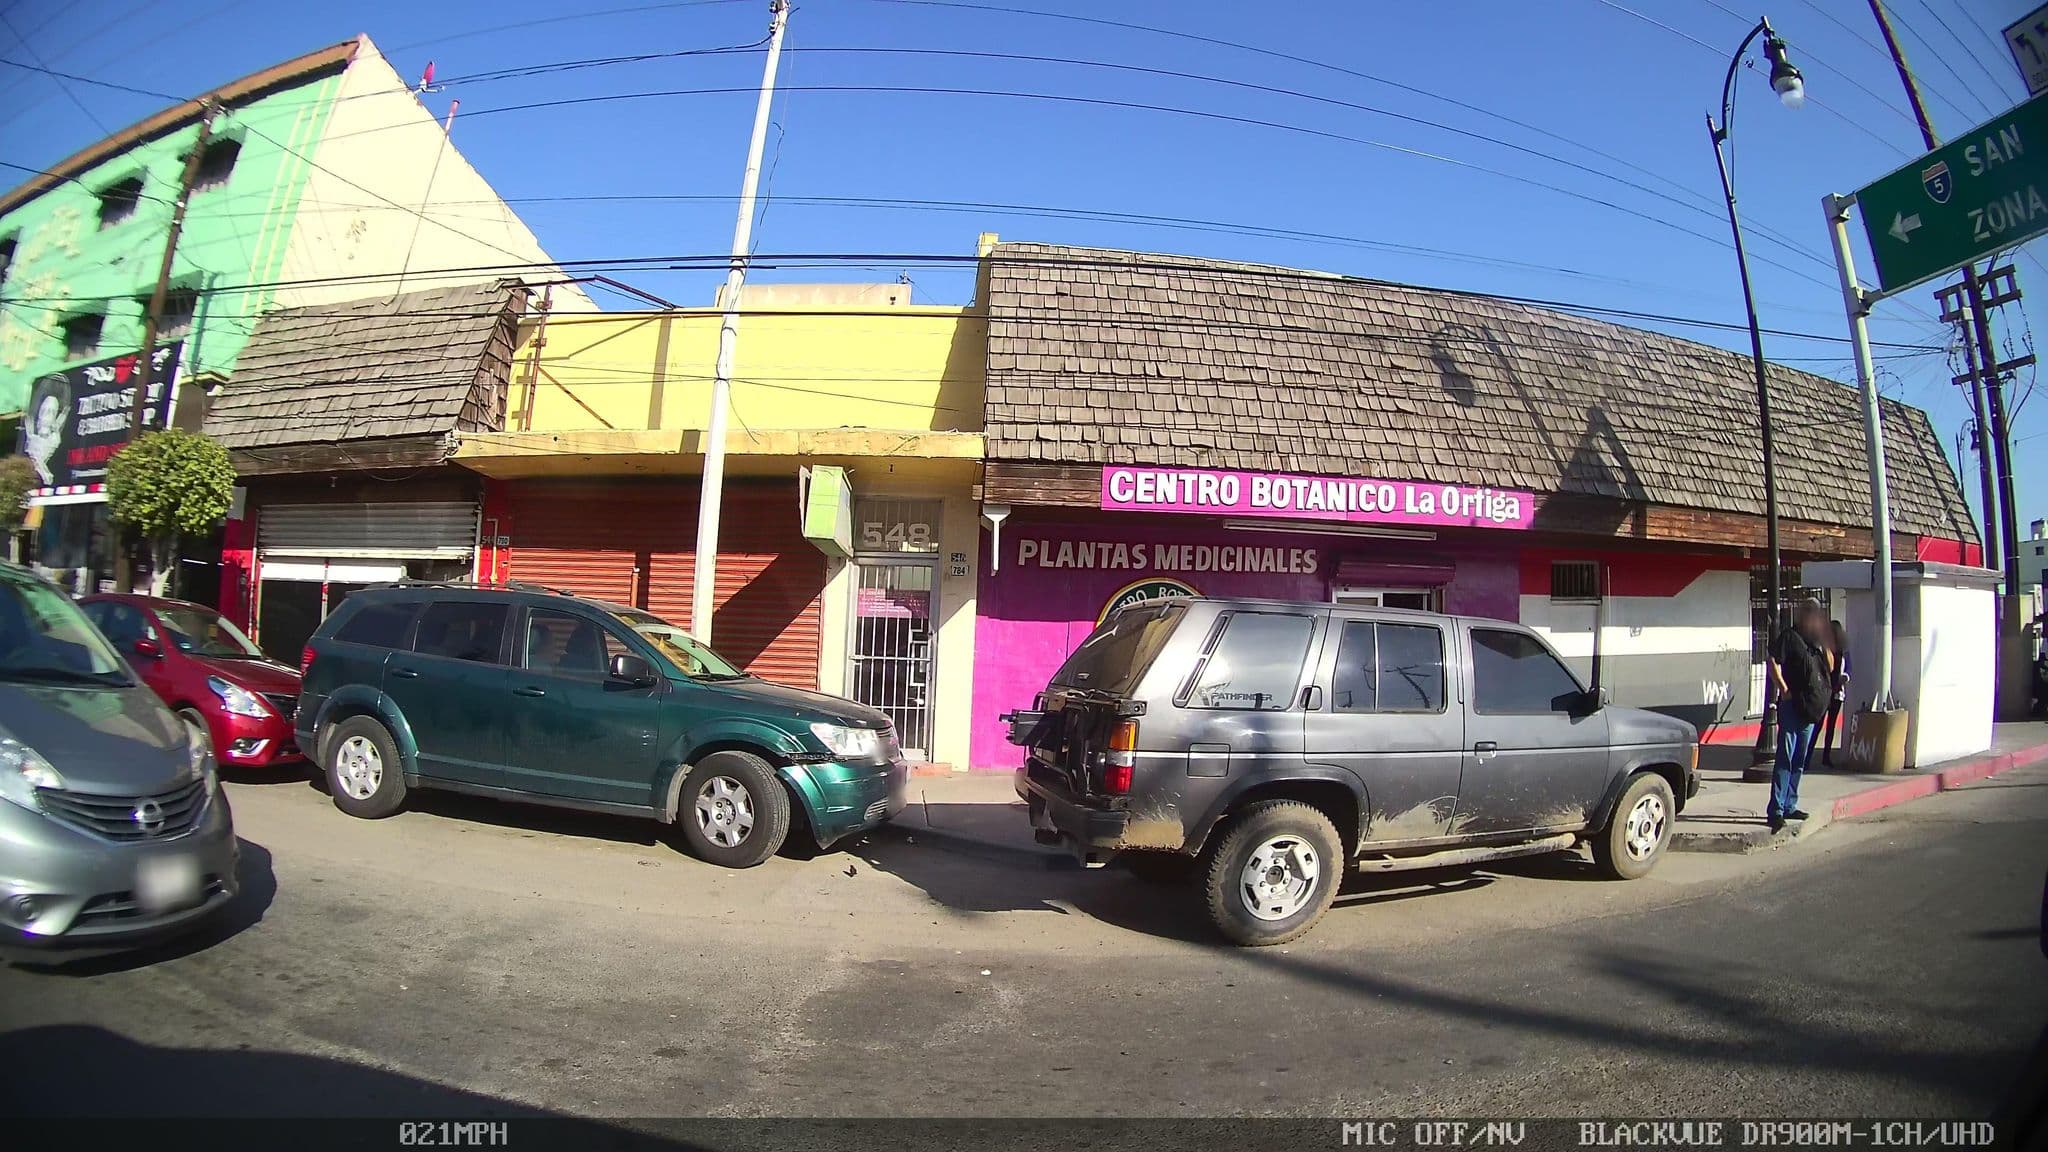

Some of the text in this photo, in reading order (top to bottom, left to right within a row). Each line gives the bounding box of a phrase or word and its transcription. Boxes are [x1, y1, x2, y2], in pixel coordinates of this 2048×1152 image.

[1964, 123, 2024, 176] SAN
[1934, 178, 1944, 194] 5
[1967, 185, 2048, 243] ZONA
[1109, 470, 1521, 523] CENTRO BOTANICO La Ortiga
[863, 522, 931, 549] 548
[1018, 539, 1318, 574] PLANTAS MEDICINALES
